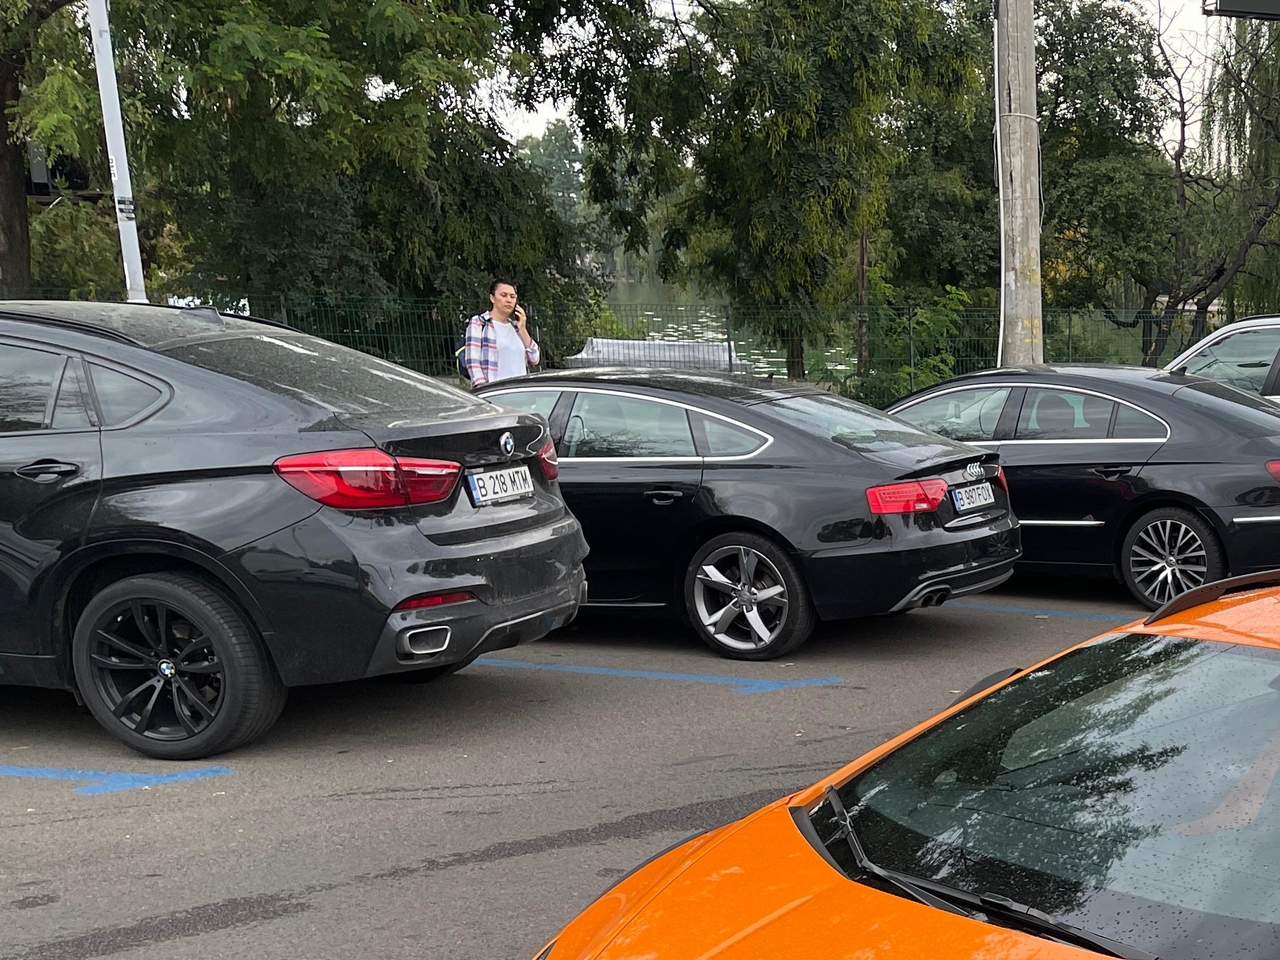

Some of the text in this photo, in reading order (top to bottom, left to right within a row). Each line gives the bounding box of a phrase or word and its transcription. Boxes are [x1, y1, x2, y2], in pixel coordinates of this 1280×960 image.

[476, 469, 530, 498] B 218 MTM
[957, 491, 965, 507] B
